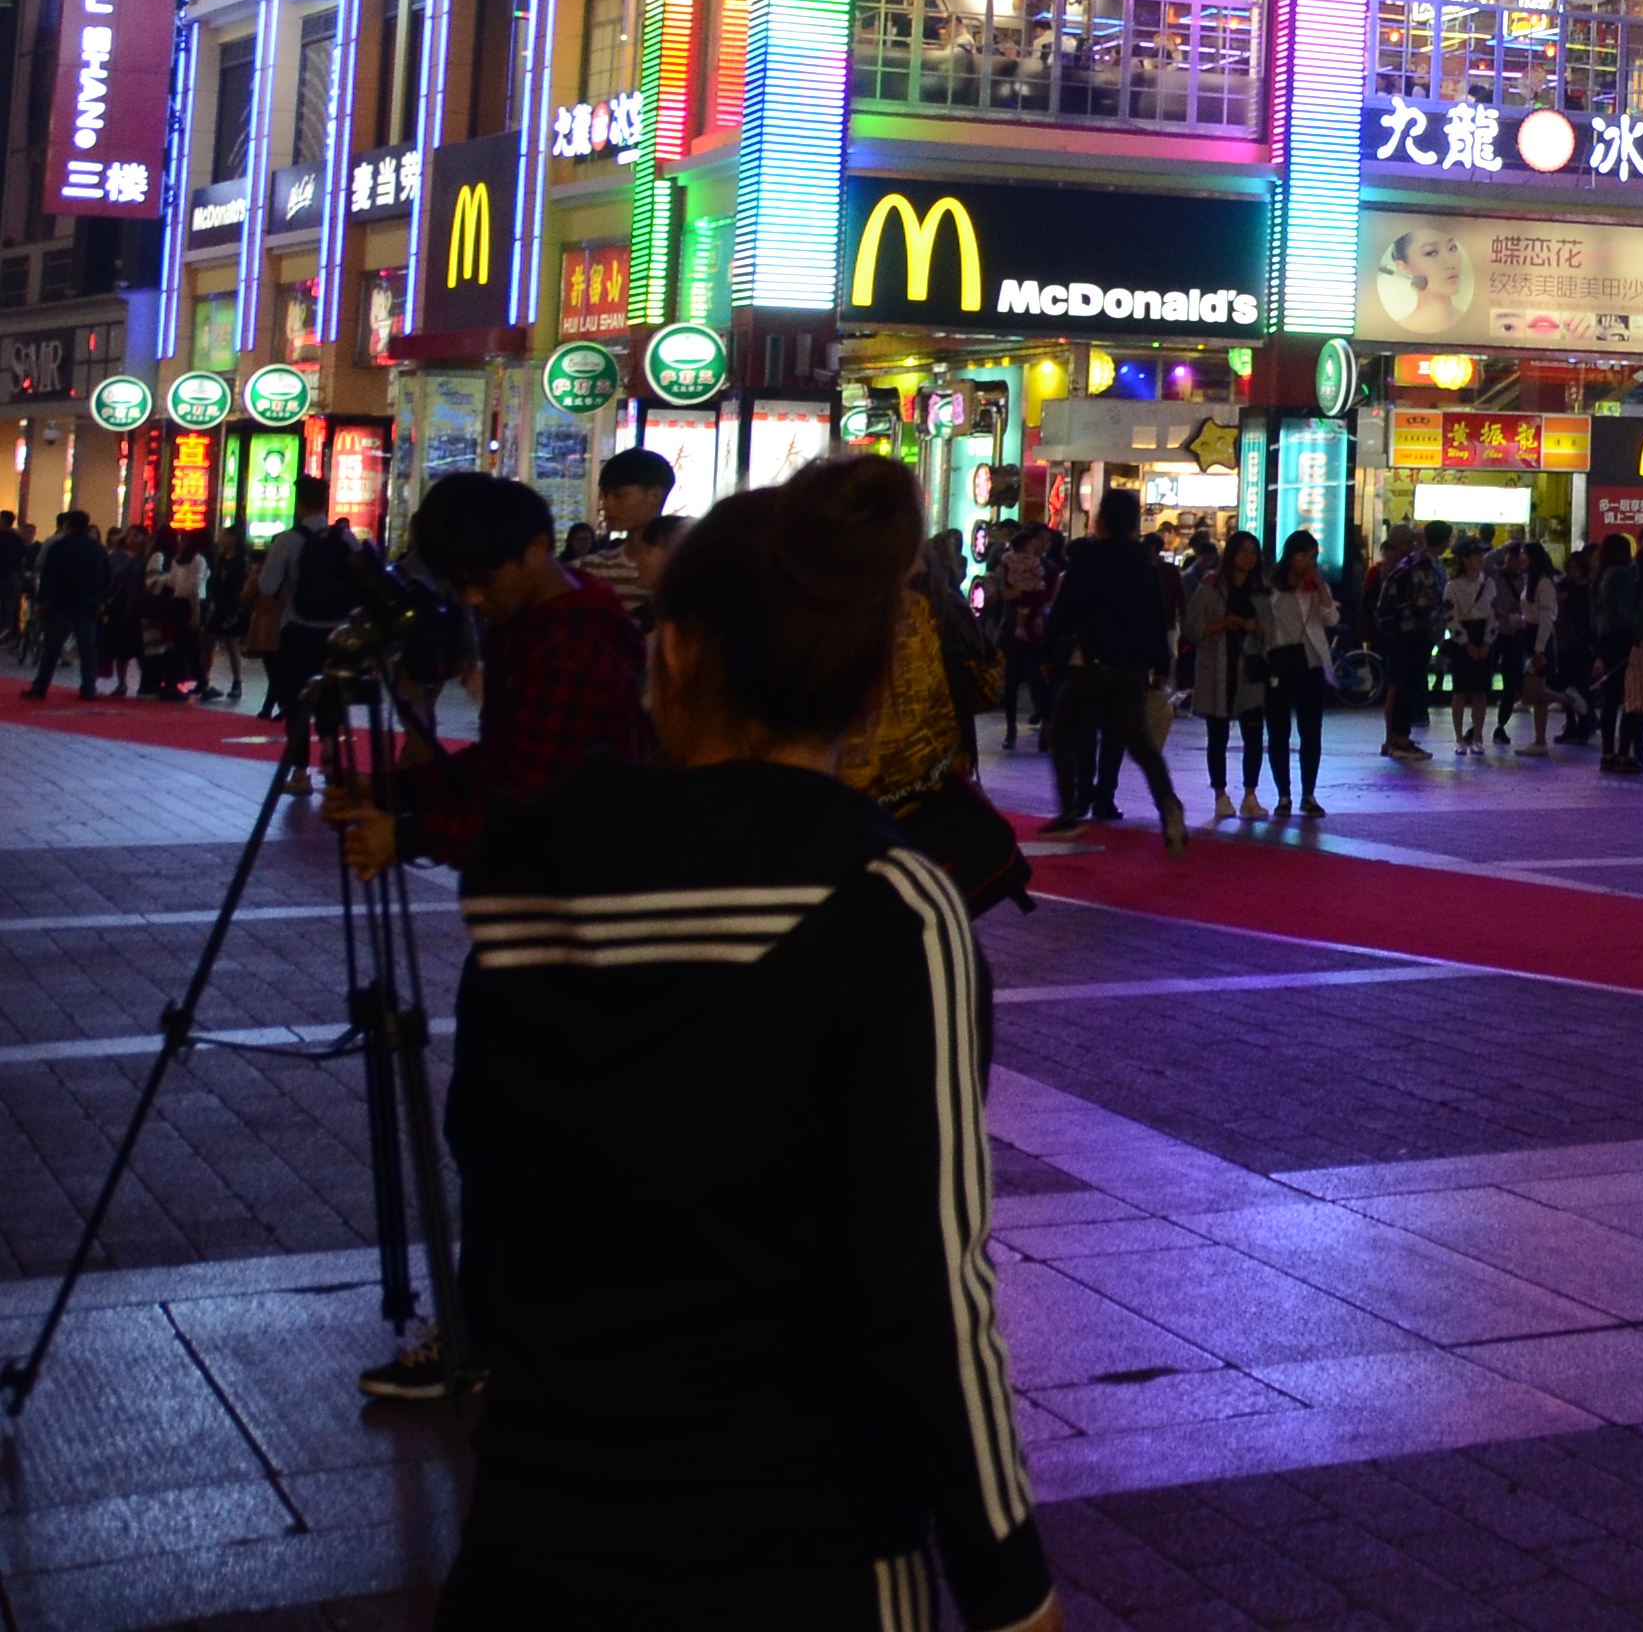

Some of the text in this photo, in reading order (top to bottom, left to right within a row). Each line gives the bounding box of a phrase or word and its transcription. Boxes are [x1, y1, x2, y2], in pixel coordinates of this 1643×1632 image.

[1378, 96, 1502, 173] 九龍
[61, 159, 149, 204] 三楼
[351, 151, 423, 213] 麦当劳
[192, 196, 248, 232] McDonald's
[1490, 235, 1584, 269] 蝶恋花
[563, 313, 627, 334] HUI LAU SHAN
[997, 278, 1258, 325] McDonald's
[171, 432, 211, 532] 直通车
[337, 455, 364, 480] 15
